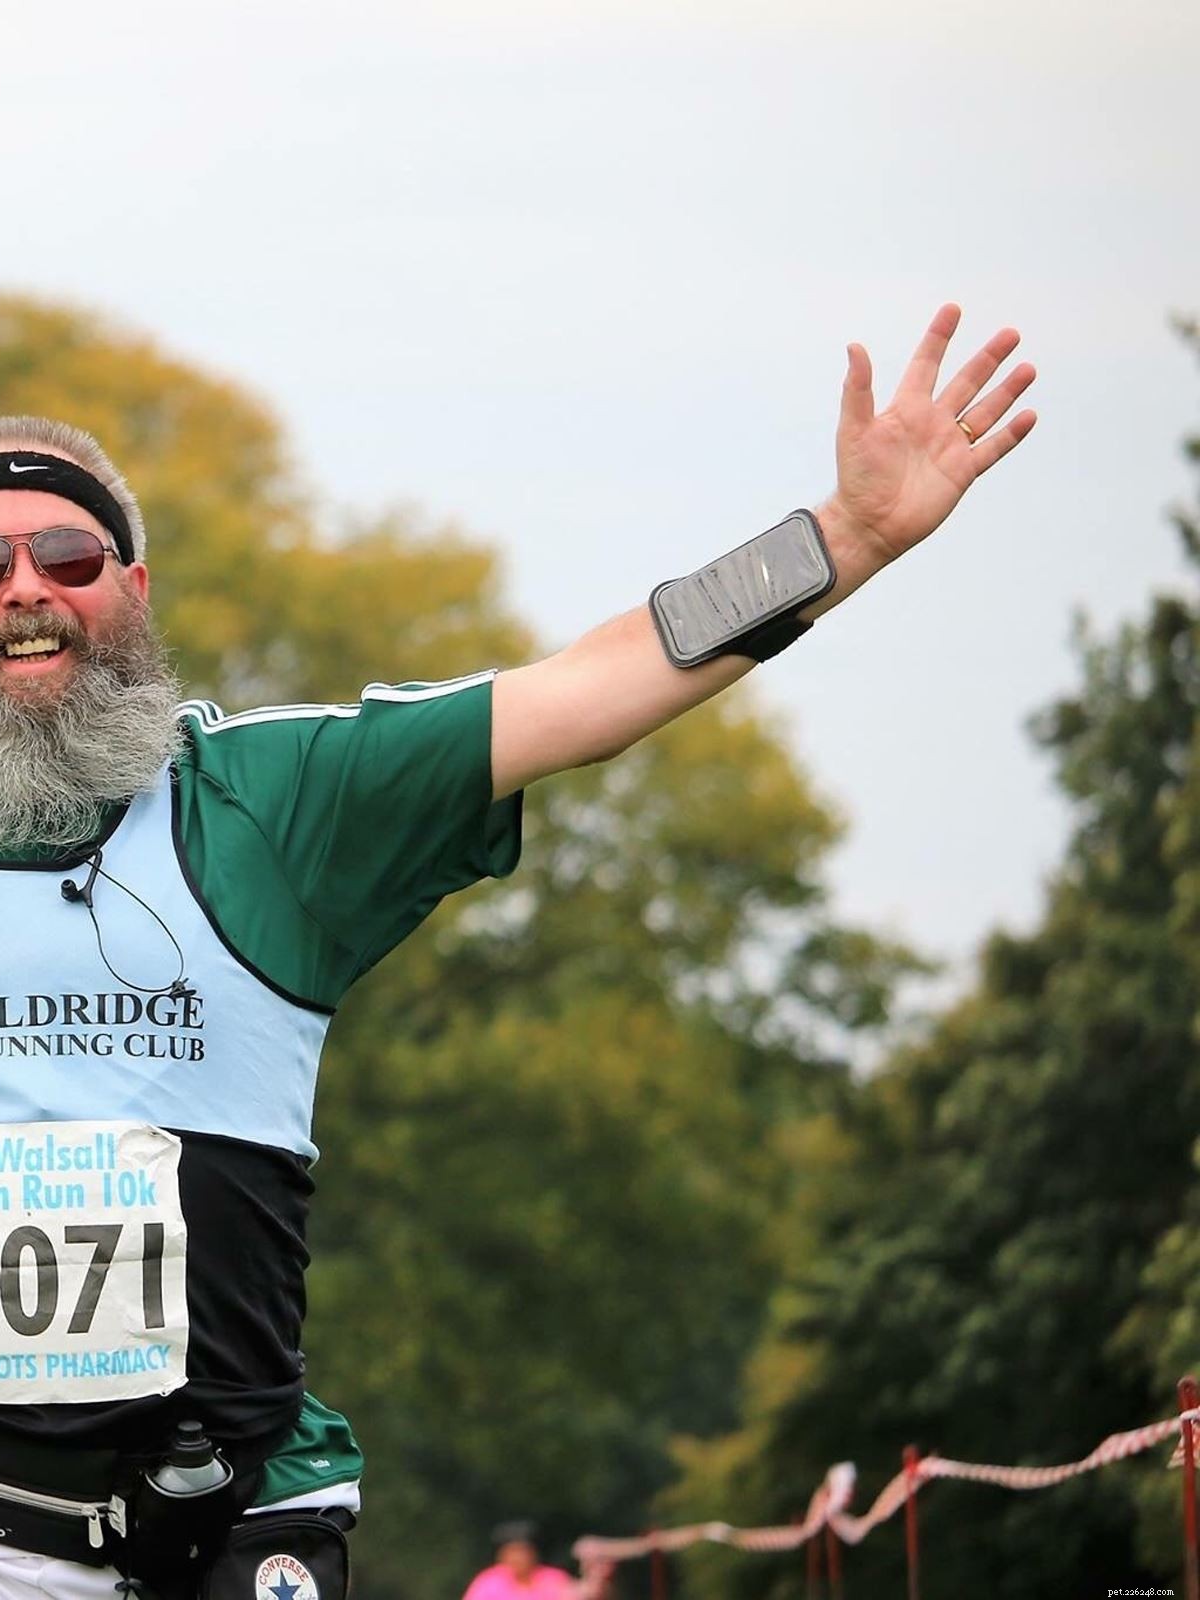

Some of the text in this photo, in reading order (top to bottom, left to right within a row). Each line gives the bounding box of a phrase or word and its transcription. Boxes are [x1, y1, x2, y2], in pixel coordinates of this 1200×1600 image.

[123, 1033, 205, 1062] CLUB
[22, 1174, 86, 1210] Run
[102, 1169, 157, 1207] 10k
[46, 1345, 171, 1379] PHARMACY
[259, 1557, 309, 1586] CONVERSE
